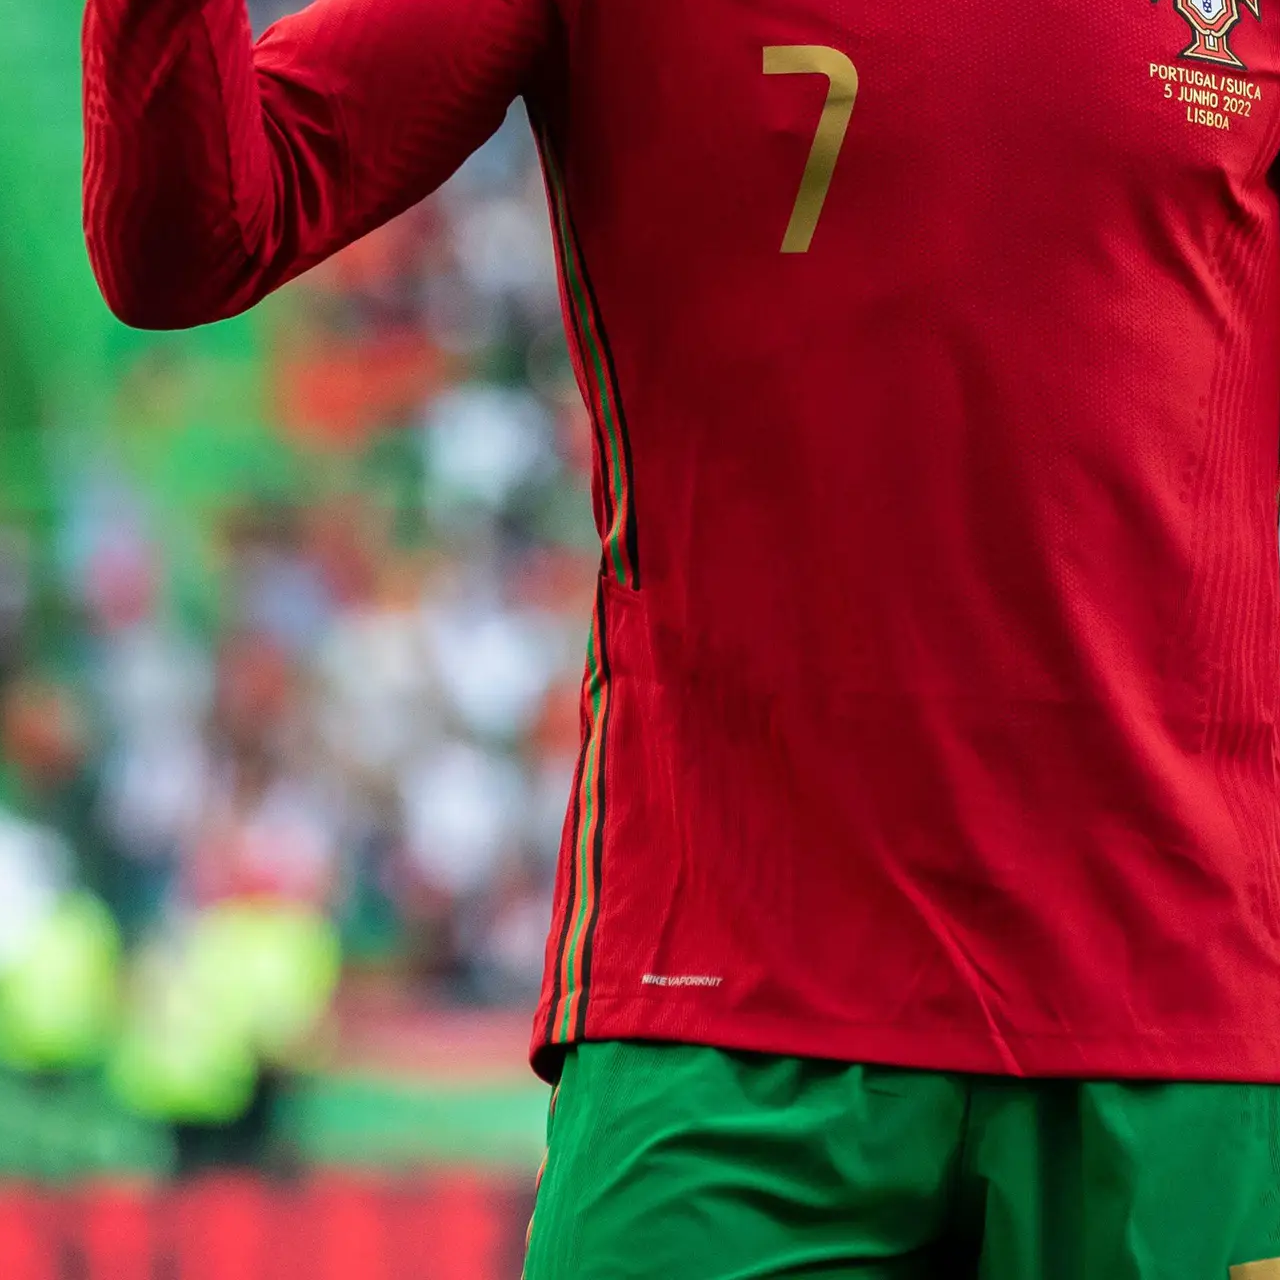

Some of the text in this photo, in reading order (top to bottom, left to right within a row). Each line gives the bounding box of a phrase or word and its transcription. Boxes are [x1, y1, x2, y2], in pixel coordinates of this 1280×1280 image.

[1163, 83, 1252, 117] 5 JUNHO 2022
[1187, 106, 1230, 131] LISBOA
[762, 45, 858, 253] 7
[641, 974, 667, 986] NIKE
